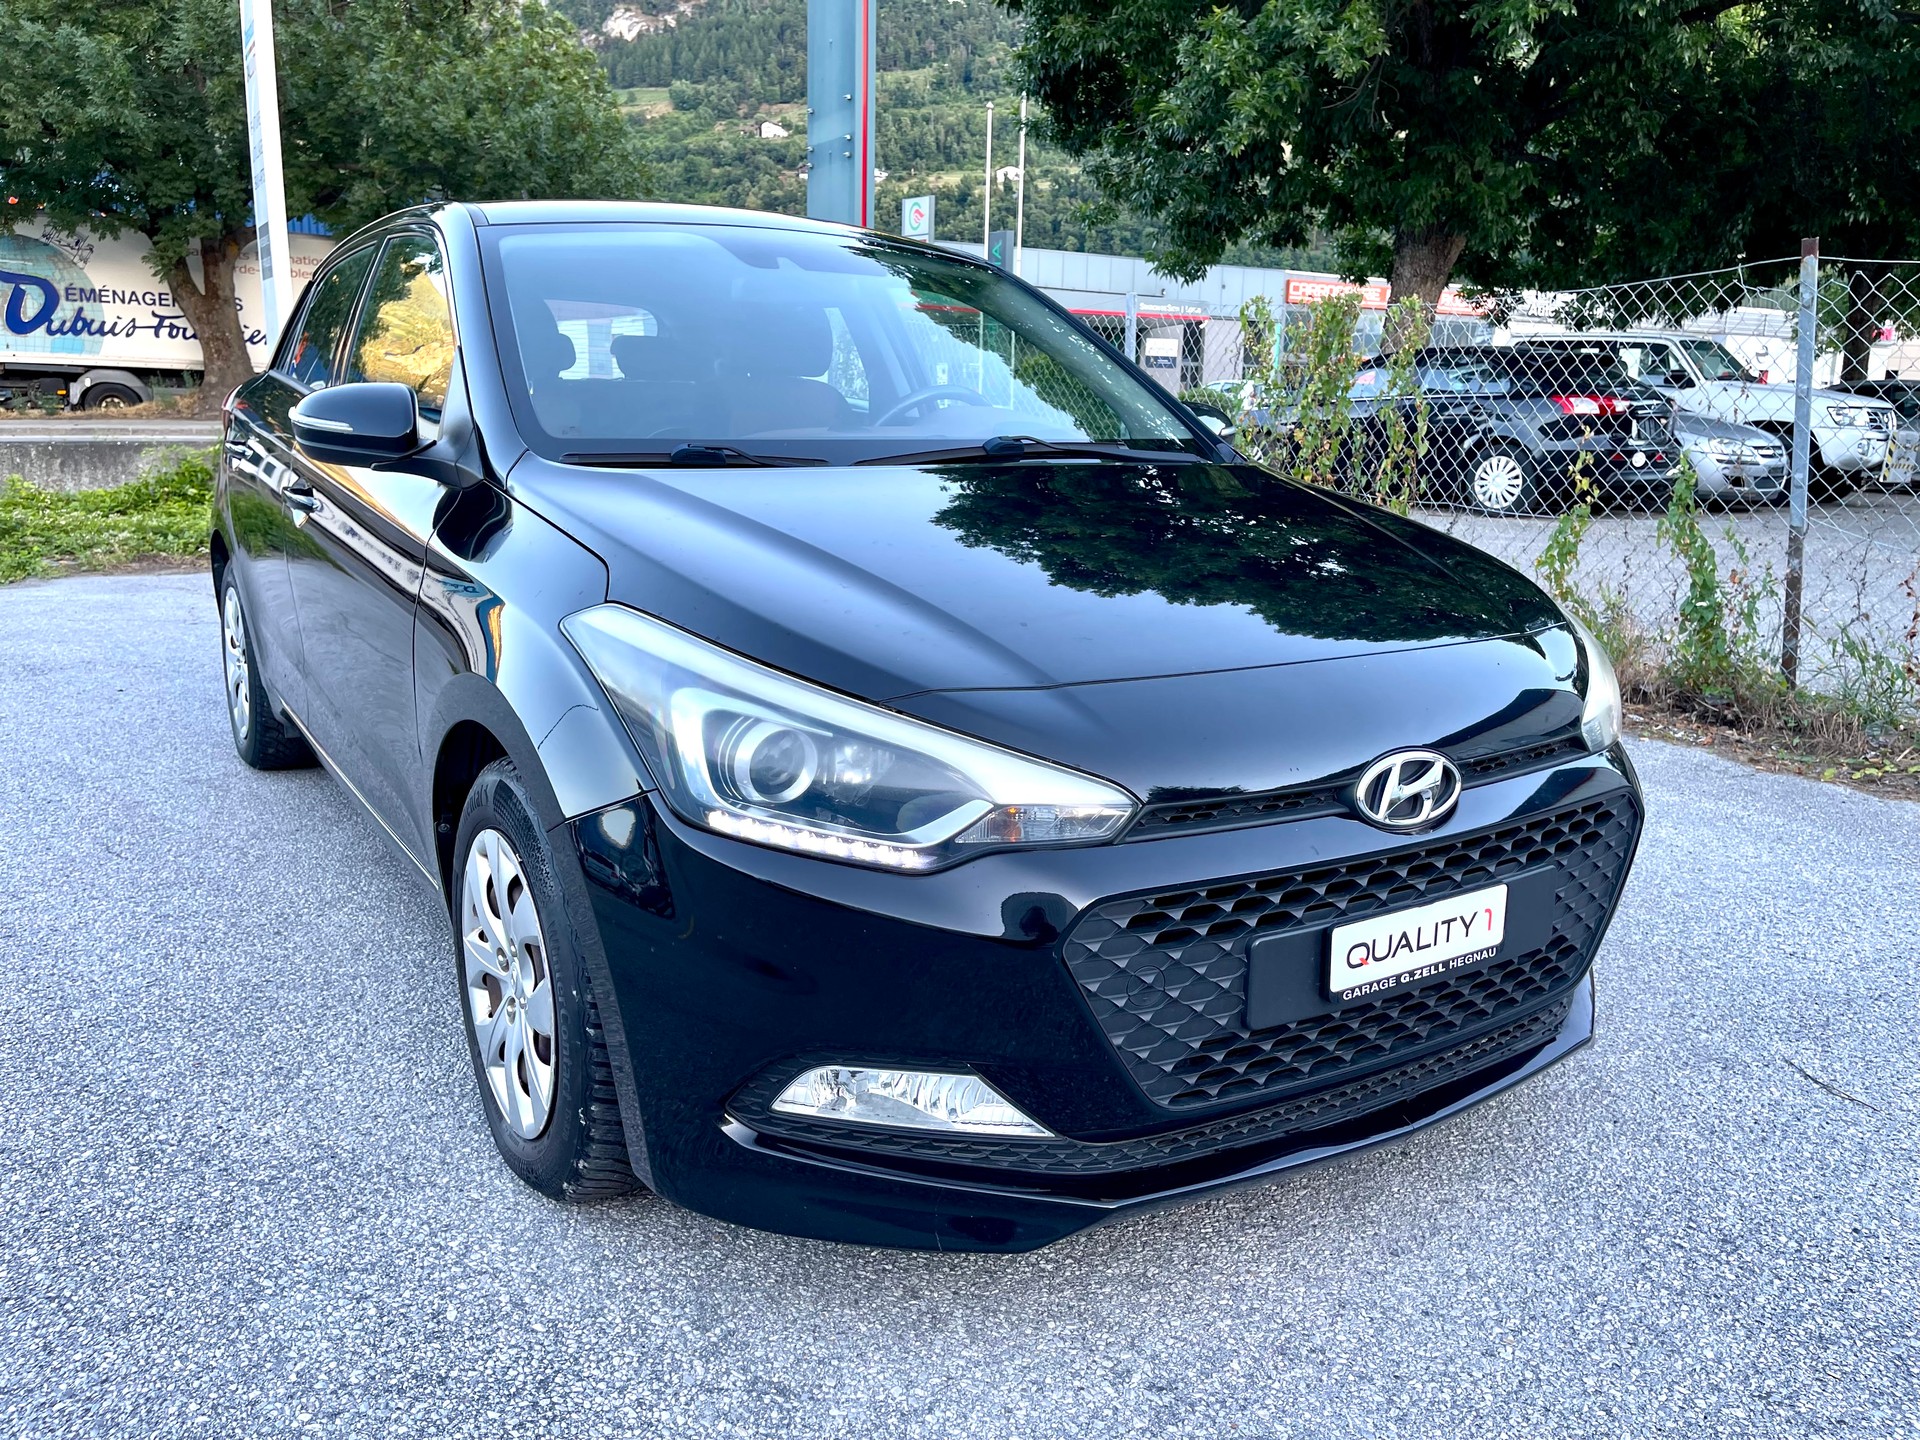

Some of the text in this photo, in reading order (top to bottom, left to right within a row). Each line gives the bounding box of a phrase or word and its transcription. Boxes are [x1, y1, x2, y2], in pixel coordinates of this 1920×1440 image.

[1342, 947, 1497, 1001] GARAGE G.ZELL HEGNAU
